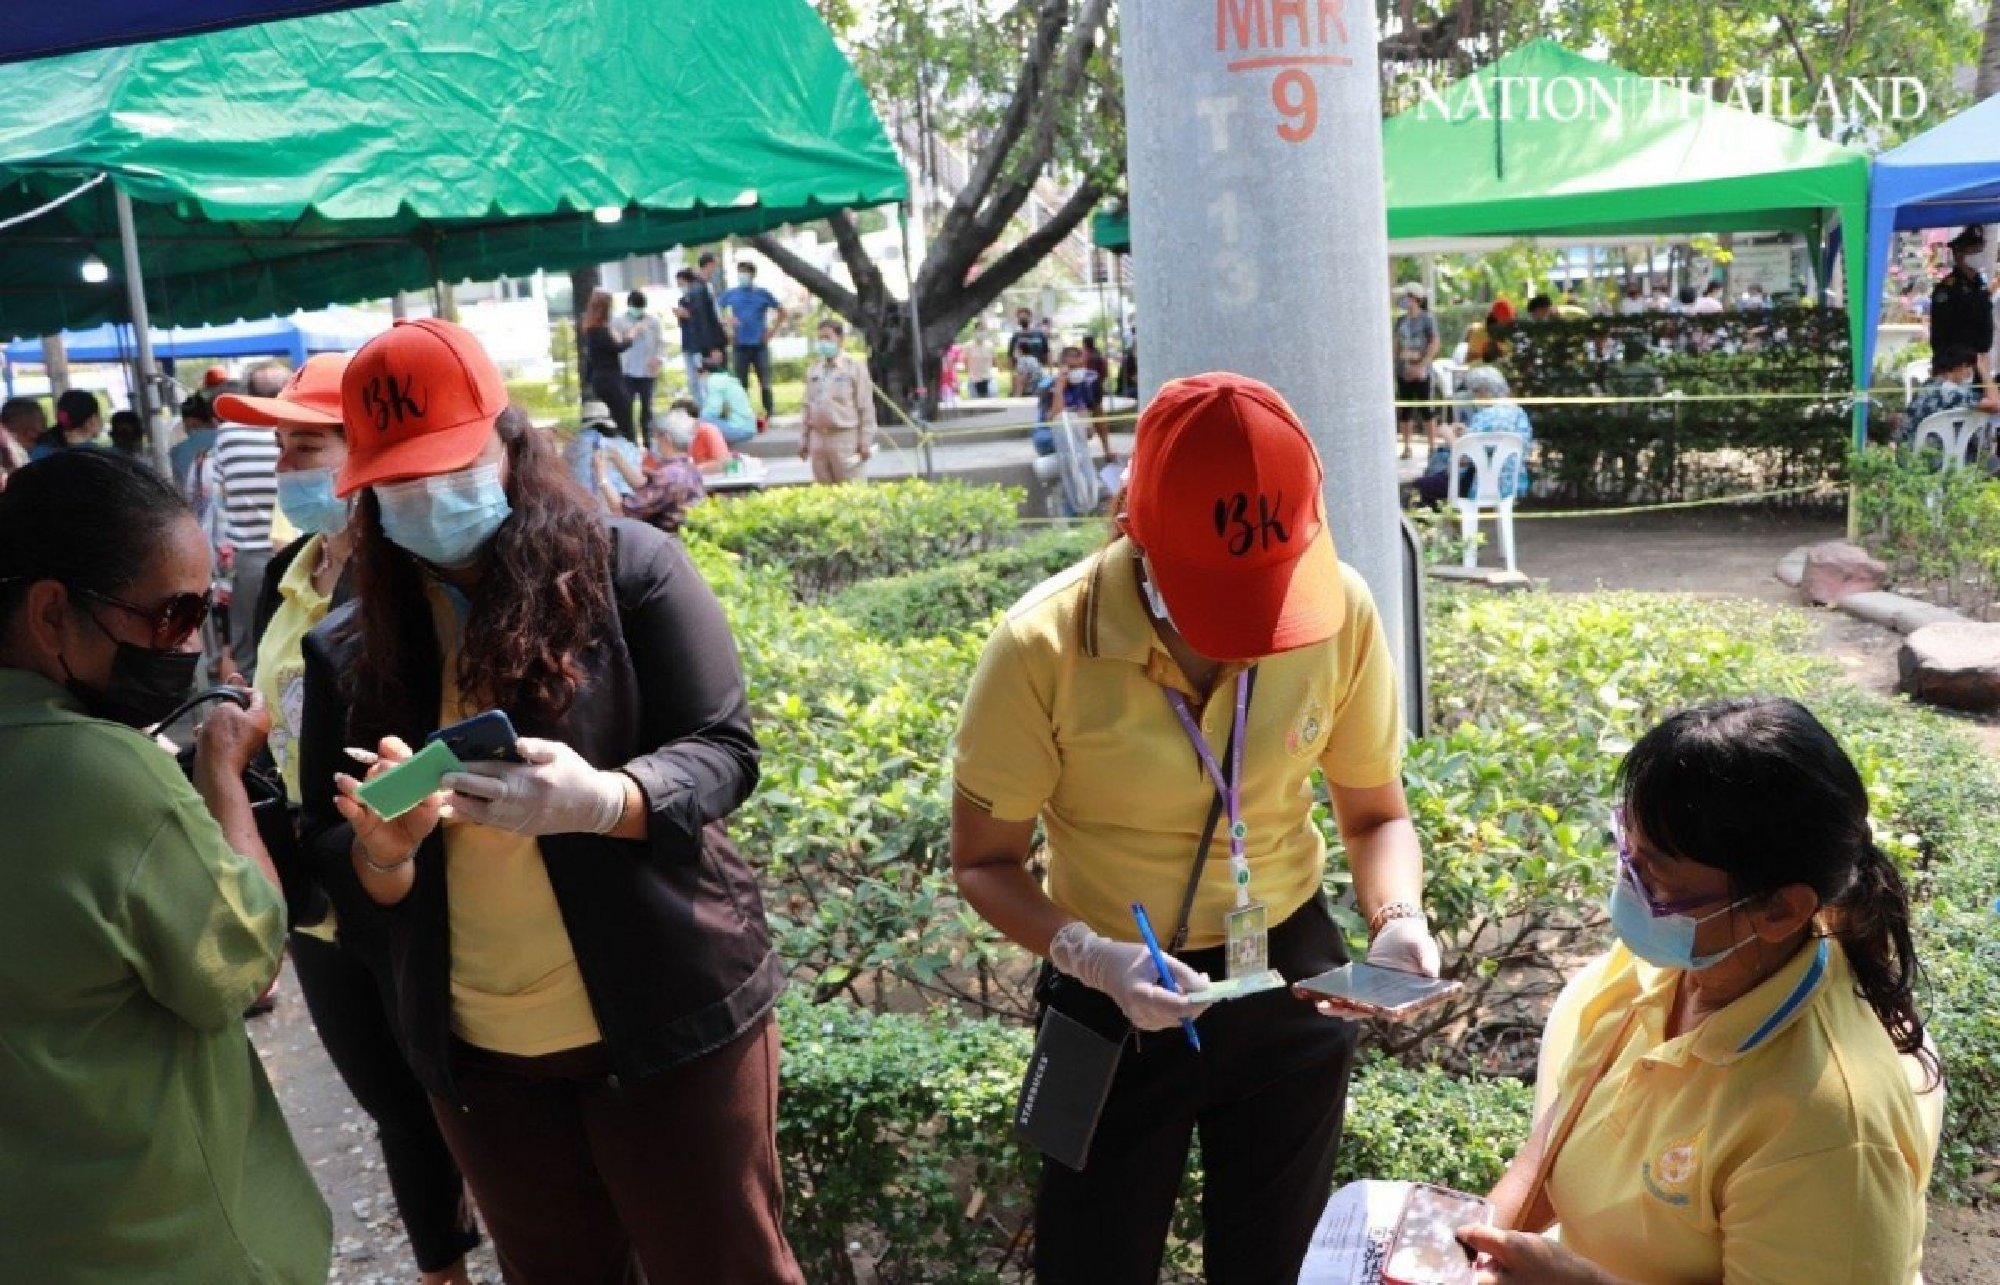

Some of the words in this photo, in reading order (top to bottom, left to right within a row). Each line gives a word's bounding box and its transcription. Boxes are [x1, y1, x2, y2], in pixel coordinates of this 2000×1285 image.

[1271, 69, 1319, 143] 9
[361, 373, 428, 432] BK
[1213, 490, 1298, 556] BK
